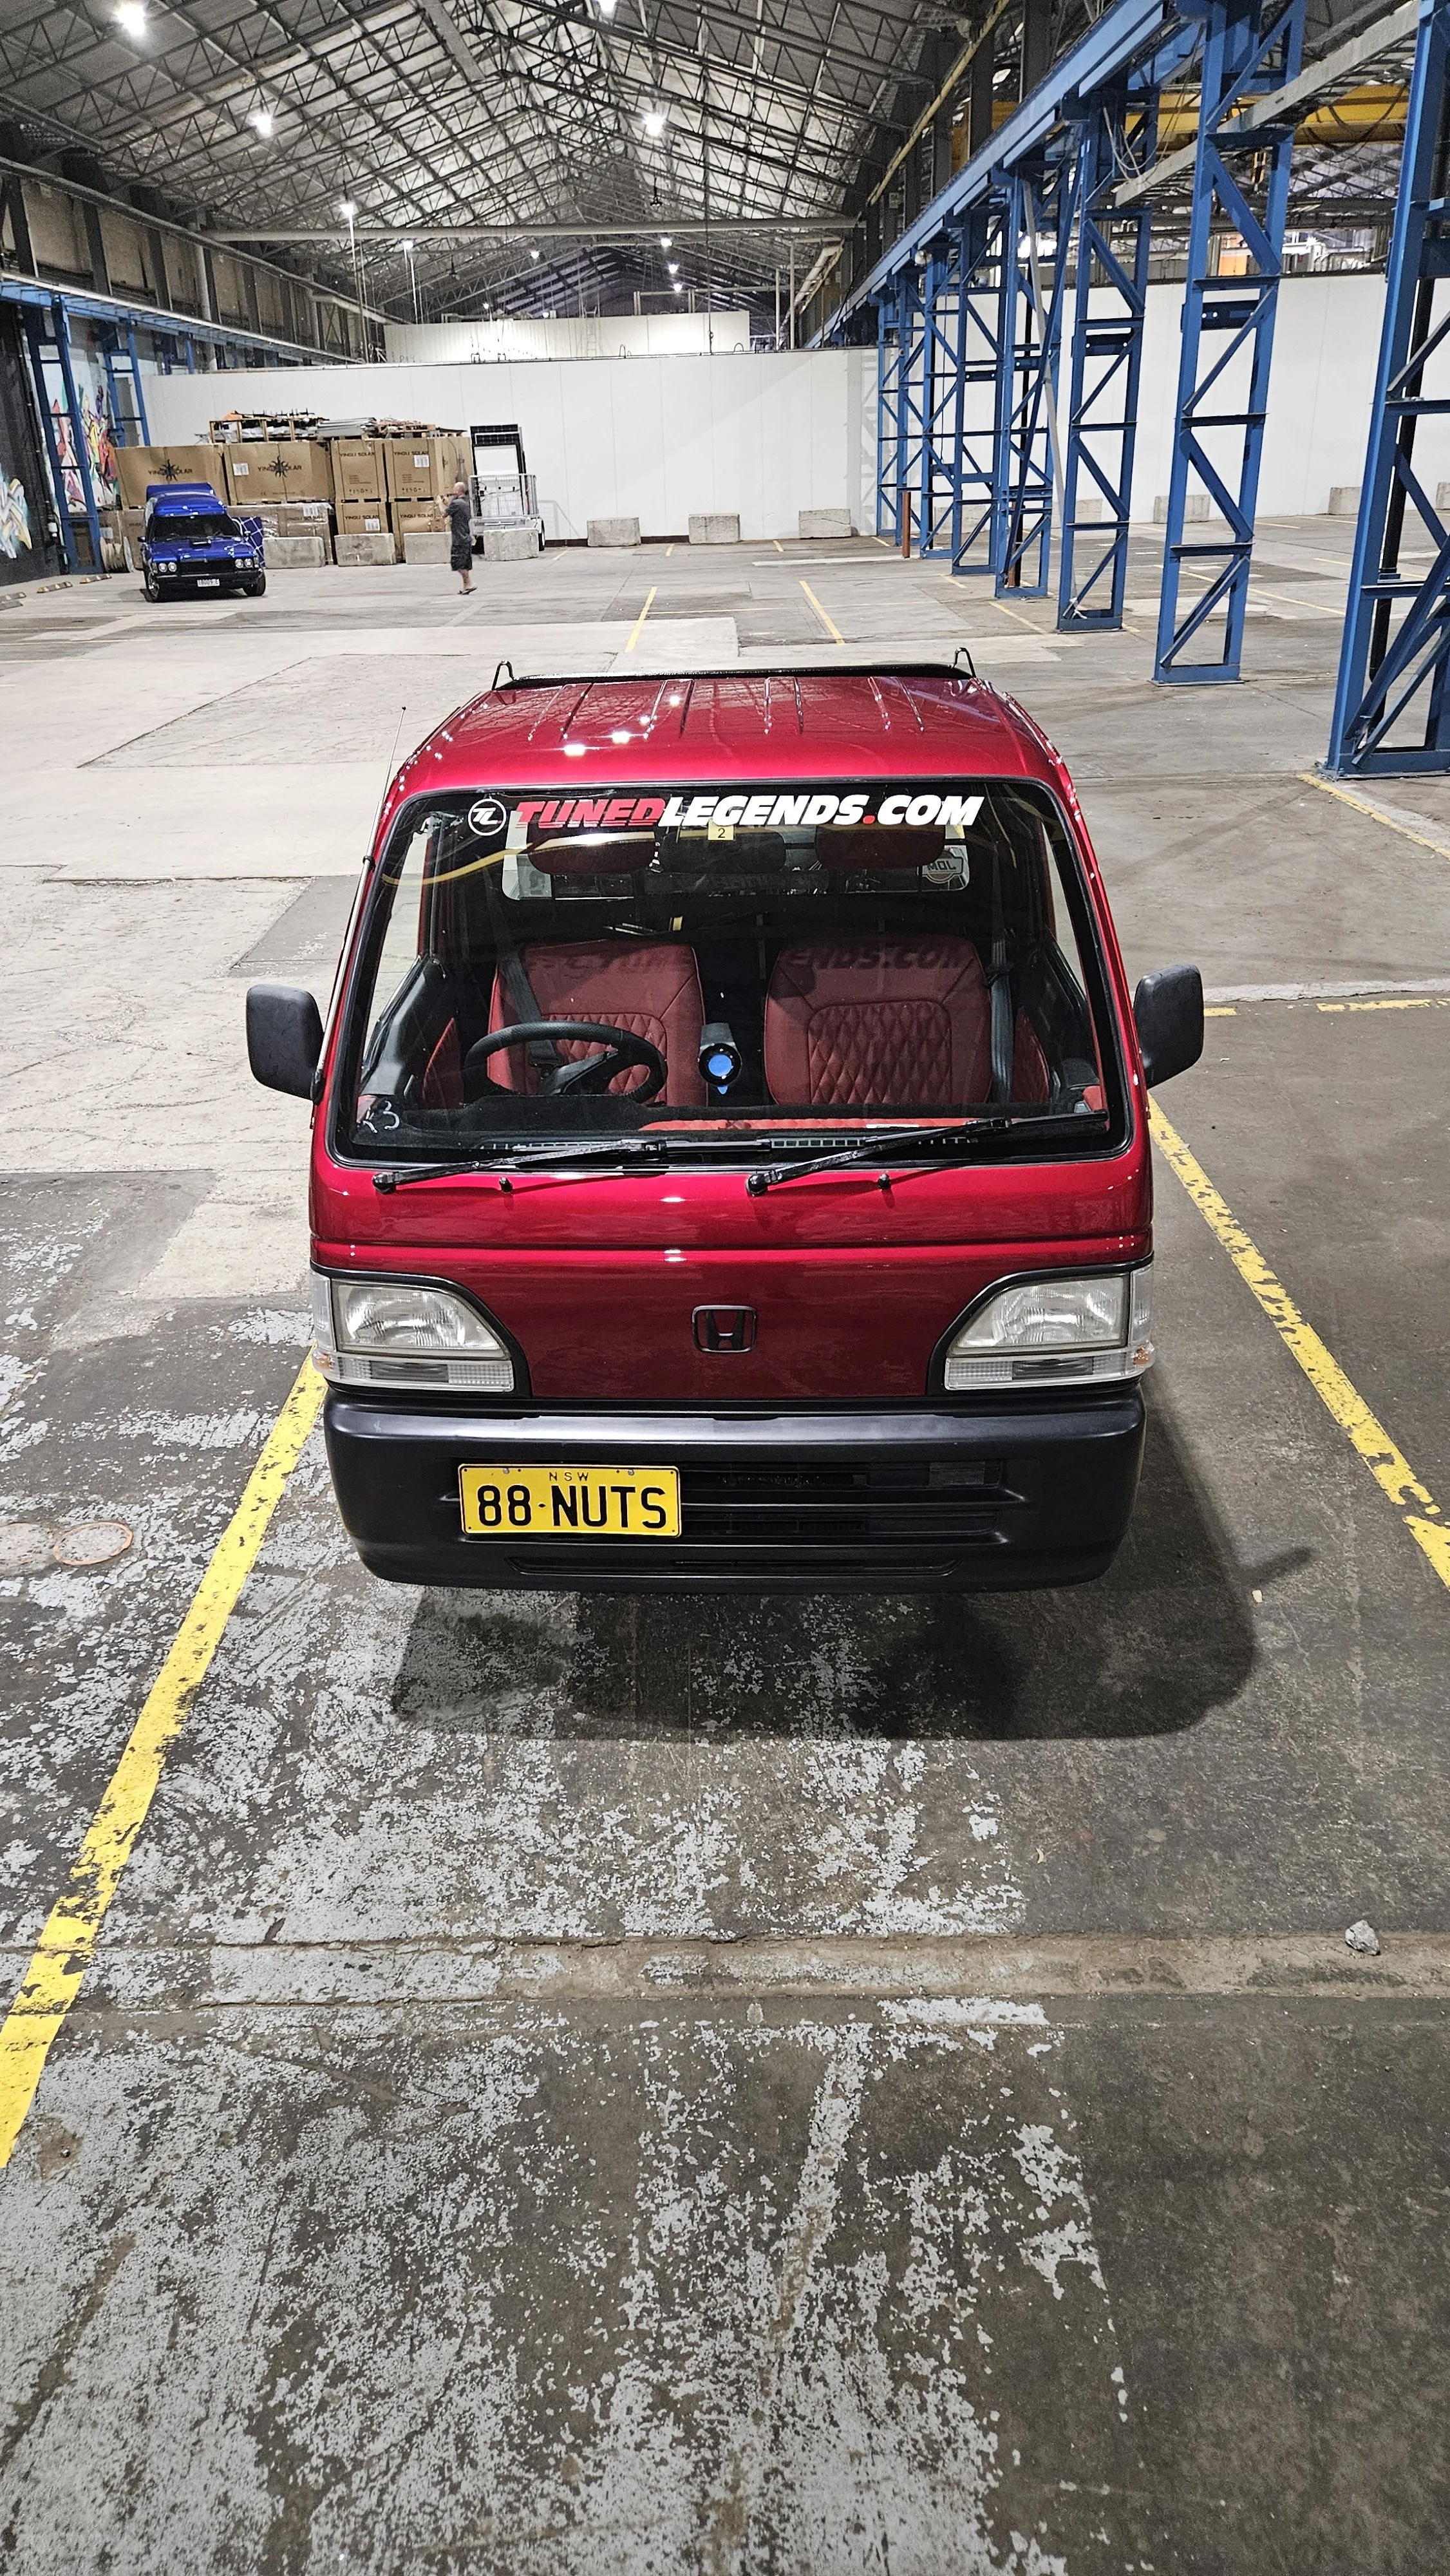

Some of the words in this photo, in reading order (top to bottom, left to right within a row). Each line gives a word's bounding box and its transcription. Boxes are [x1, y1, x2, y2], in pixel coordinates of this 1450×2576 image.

[515, 795, 984, 828] TUNEDLEGENDS.COM
[717, 828, 726, 838] 2
[549, 1472, 589, 1481] NSW
